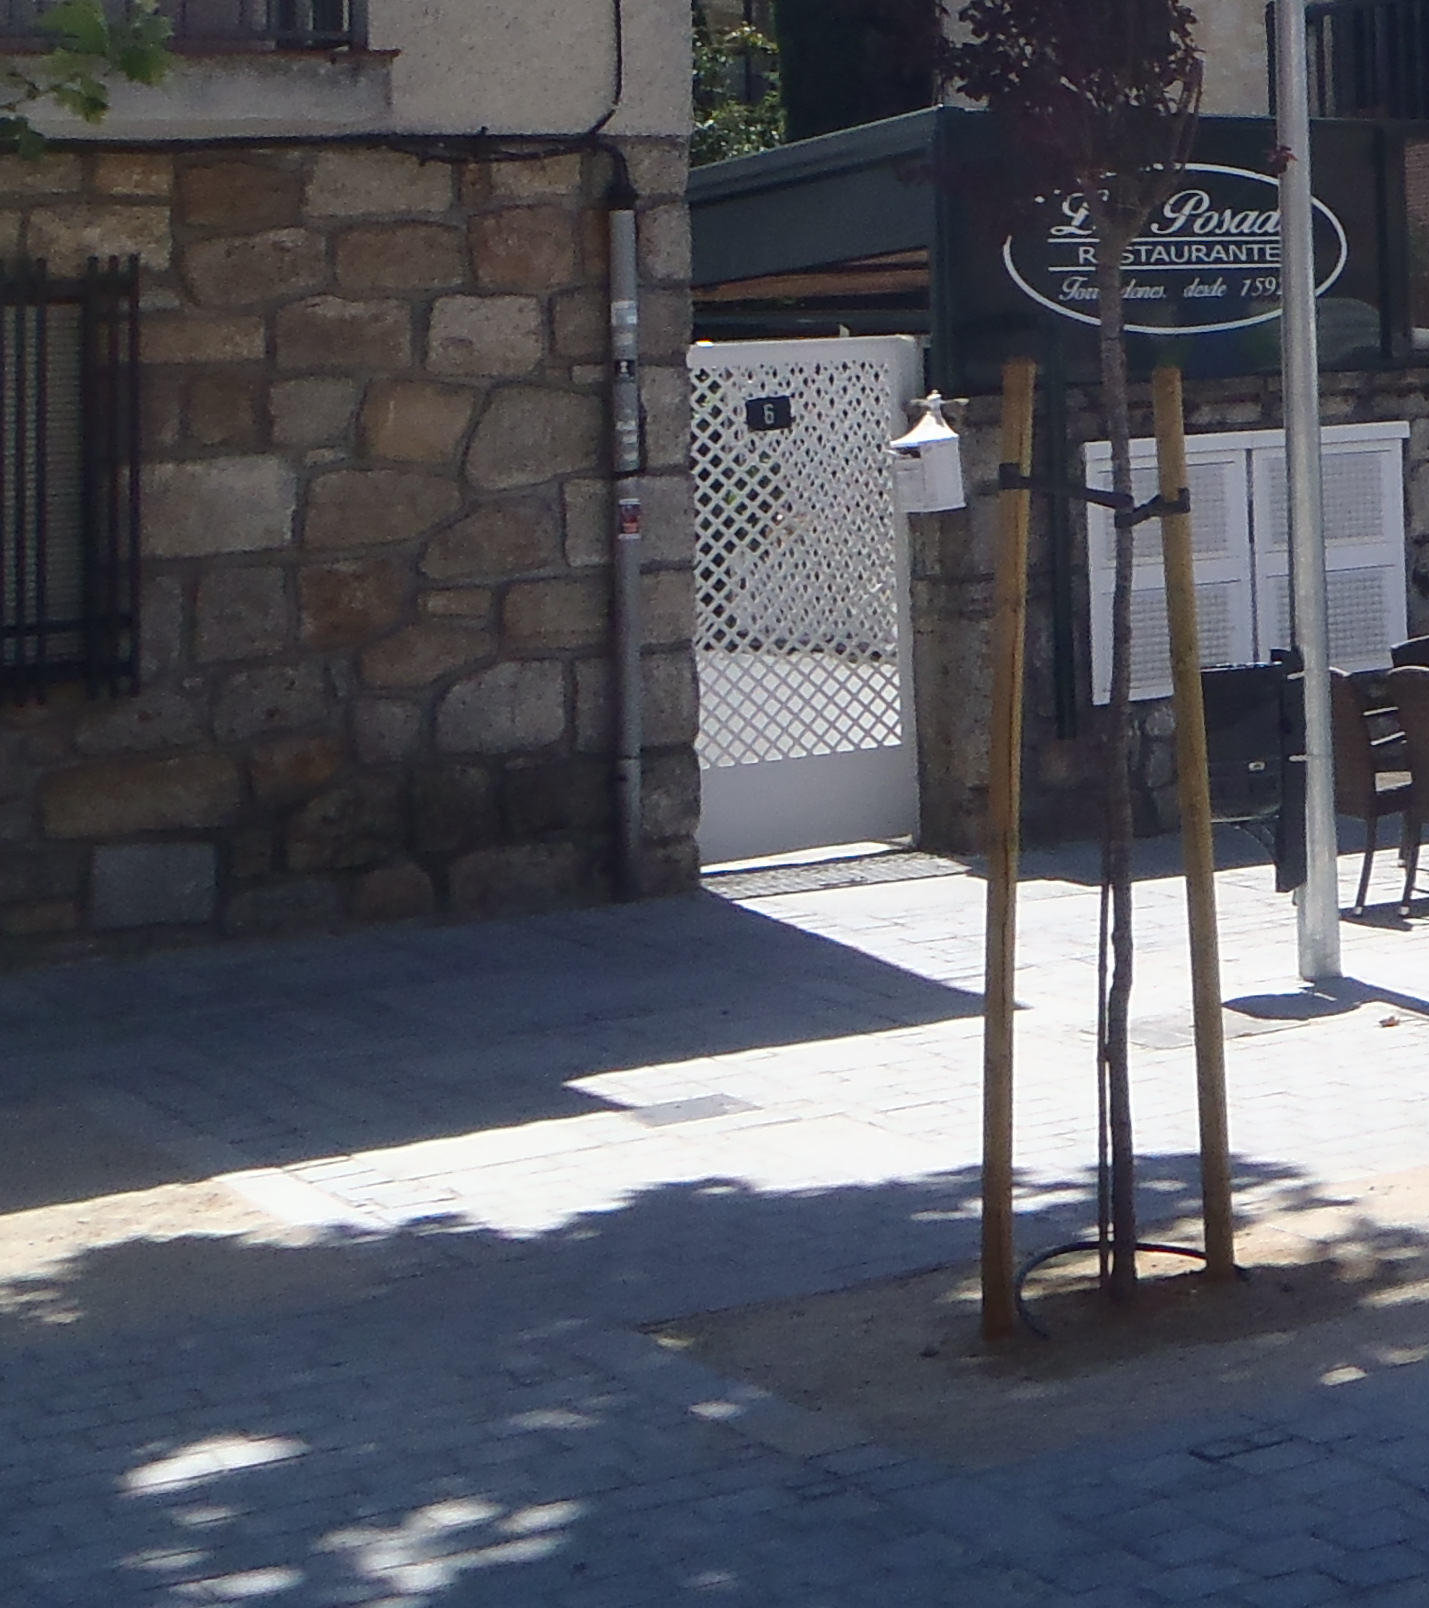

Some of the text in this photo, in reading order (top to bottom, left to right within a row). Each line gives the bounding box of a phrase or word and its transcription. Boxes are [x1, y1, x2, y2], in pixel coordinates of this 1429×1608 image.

[1150, 189, 1281, 234] Posad
[1078, 244, 1281, 264] RSTAURANTE
[1241, 276, 1281, 296] 159
[763, 403, 775, 425] 6
